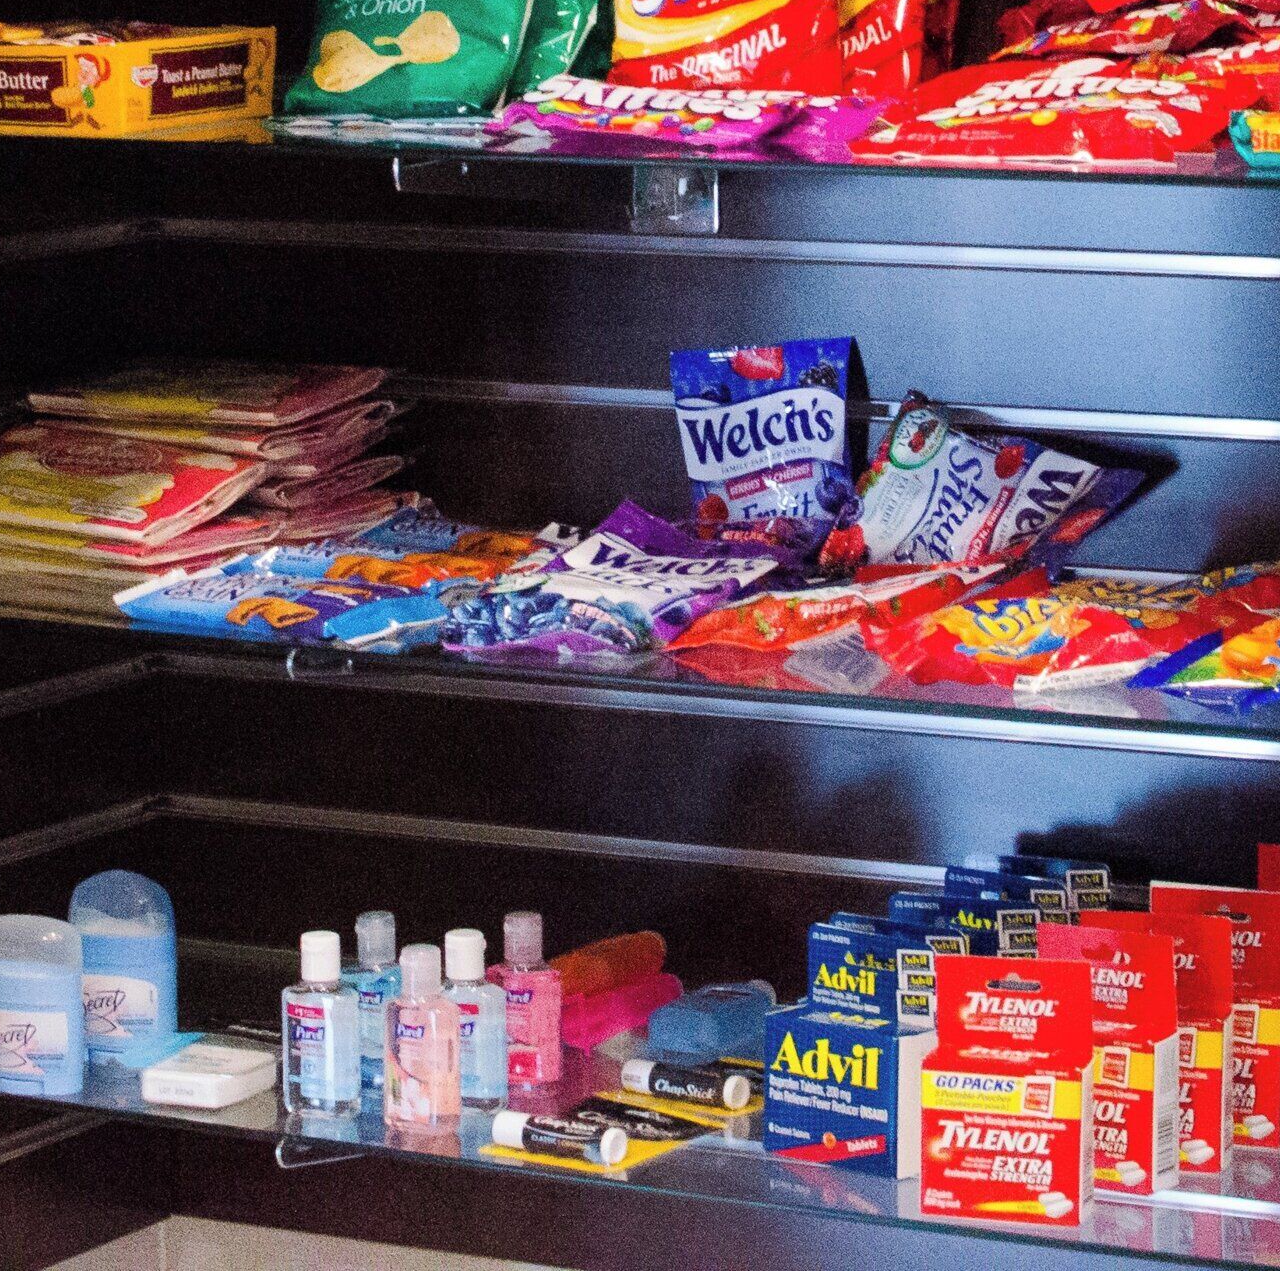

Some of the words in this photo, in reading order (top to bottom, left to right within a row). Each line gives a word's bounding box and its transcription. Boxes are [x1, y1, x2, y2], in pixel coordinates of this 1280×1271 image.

[345, 1, 361, 19] &
[650, 64, 678, 85] The
[681, 23, 789, 77] ORIGINAL
[682, 397, 835, 466] Welch's
[928, 484, 991, 562] Fruit
[903, 953, 928, 968] Advil
[813, 962, 877, 997] Advil
[964, 990, 1057, 1018] TYLENOL
[998, 1016, 1038, 1029] EXTRA
[770, 1031, 881, 1091] Advil
[653, 1077, 718, 1101] ChapStick
[935, 1074, 959, 1090] GO
[961, 1076, 1016, 1093] PACKS
[845, 1138, 879, 1153] Tablets
[935, 1119, 1054, 1156] TYLENOL
[991, 1155, 1053, 1175] EXTRA
[989, 1171, 1053, 1186] STRENGTH
